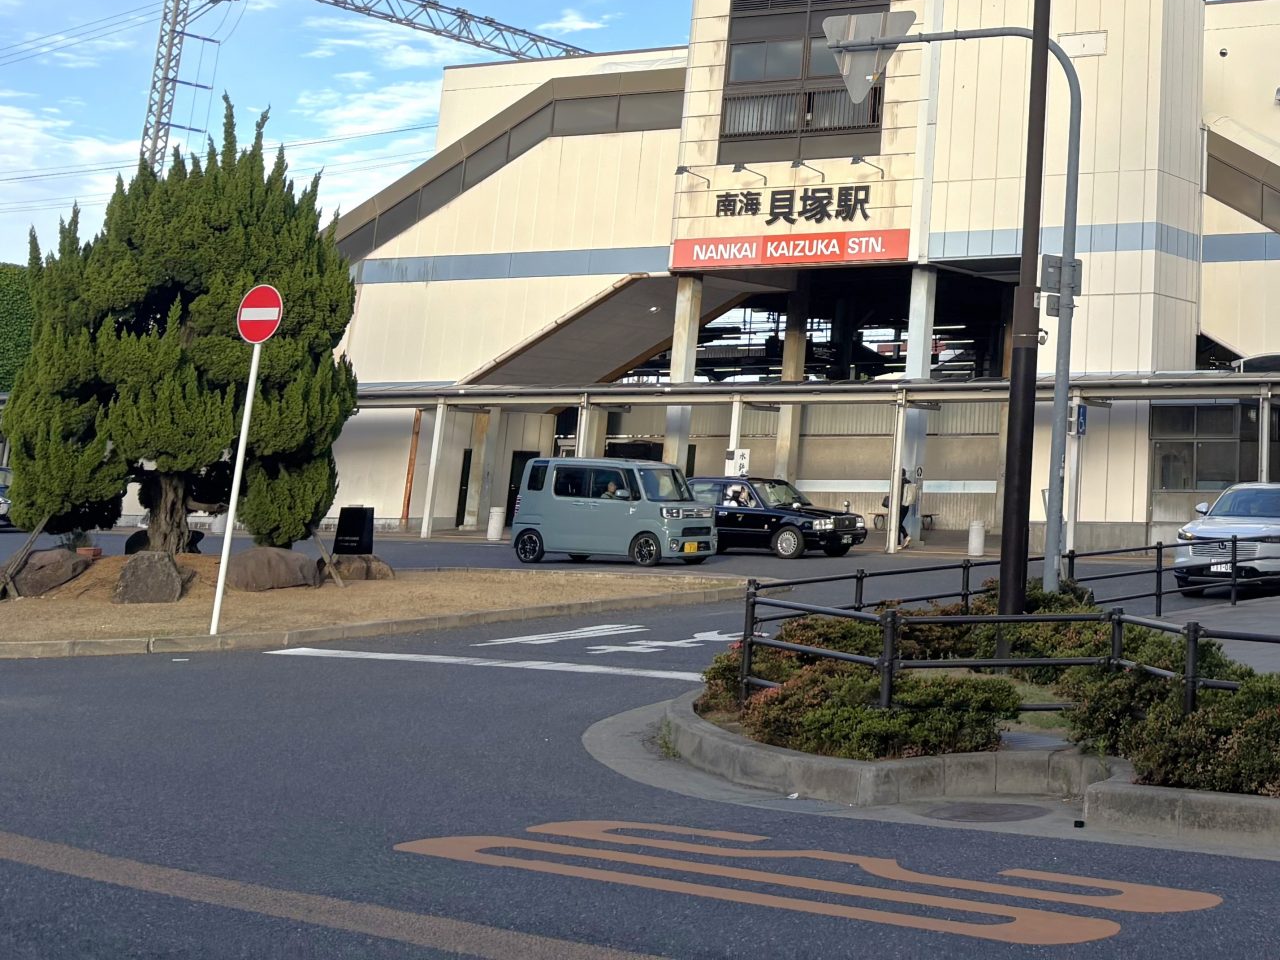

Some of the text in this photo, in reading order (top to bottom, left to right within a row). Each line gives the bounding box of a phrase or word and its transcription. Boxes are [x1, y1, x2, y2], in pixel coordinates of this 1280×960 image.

[716, 185, 871, 226] 南海 貝塚駅
[693, 236, 886, 260] NANKAI KAIZUKA STN.
